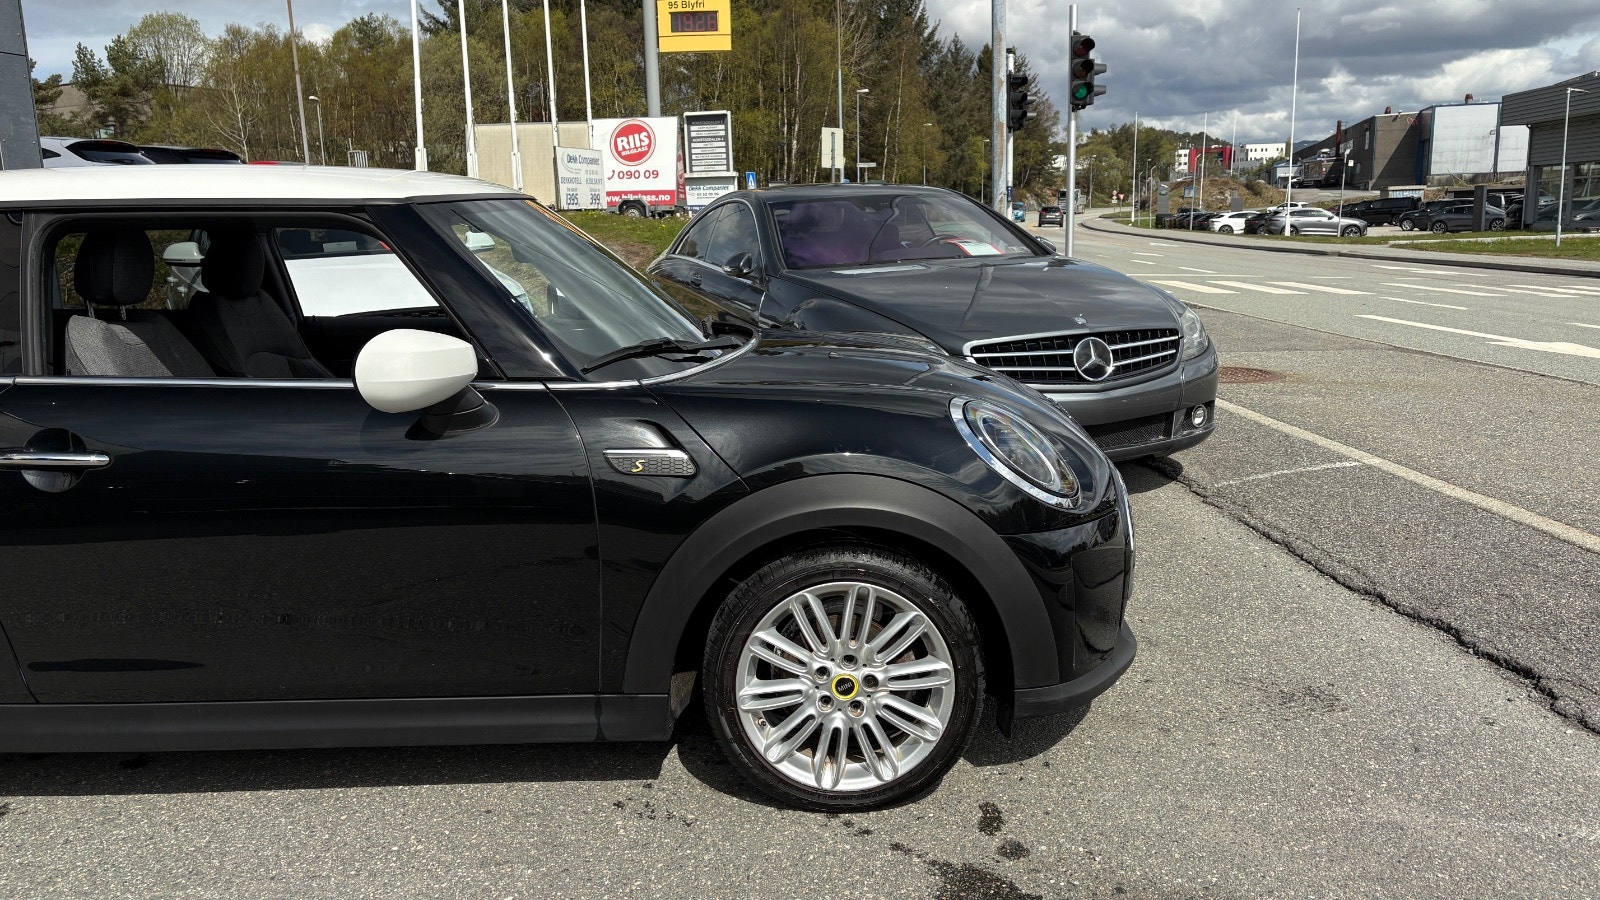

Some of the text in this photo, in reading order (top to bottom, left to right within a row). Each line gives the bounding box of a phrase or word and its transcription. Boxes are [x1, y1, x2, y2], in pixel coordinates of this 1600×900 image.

[668, 0, 704, 10] 95 Blyfri
[616, 132, 650, 151] RIIS
[621, 146, 648, 156] BILGLASS
[567, 154, 578, 164] Dekk
[618, 170, 659, 179] 090 09
[631, 459, 645, 473] S
[837, 682, 852, 692] MINI
